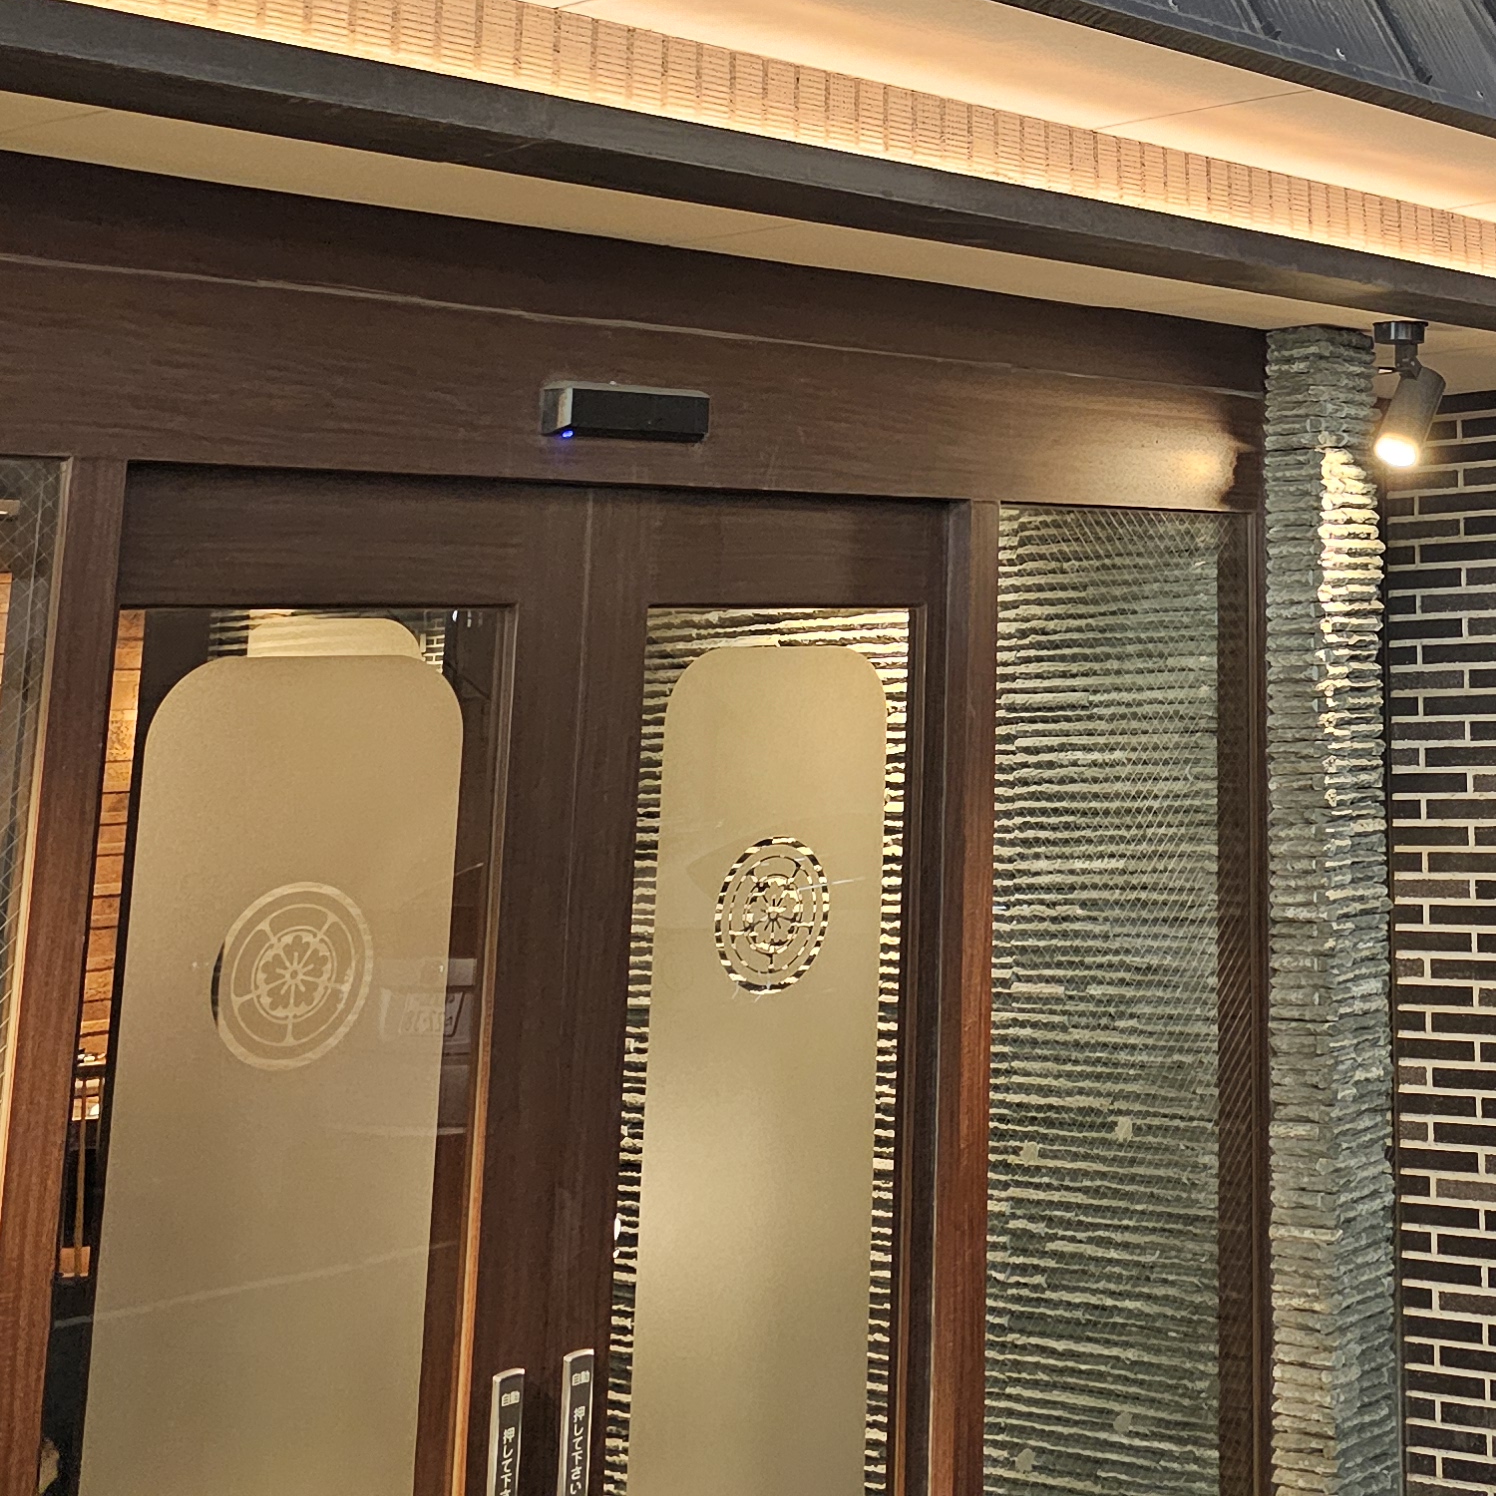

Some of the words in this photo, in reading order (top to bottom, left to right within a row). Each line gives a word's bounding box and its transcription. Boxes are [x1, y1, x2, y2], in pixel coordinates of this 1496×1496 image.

[569, 1406, 586, 1495] 押して下さい
